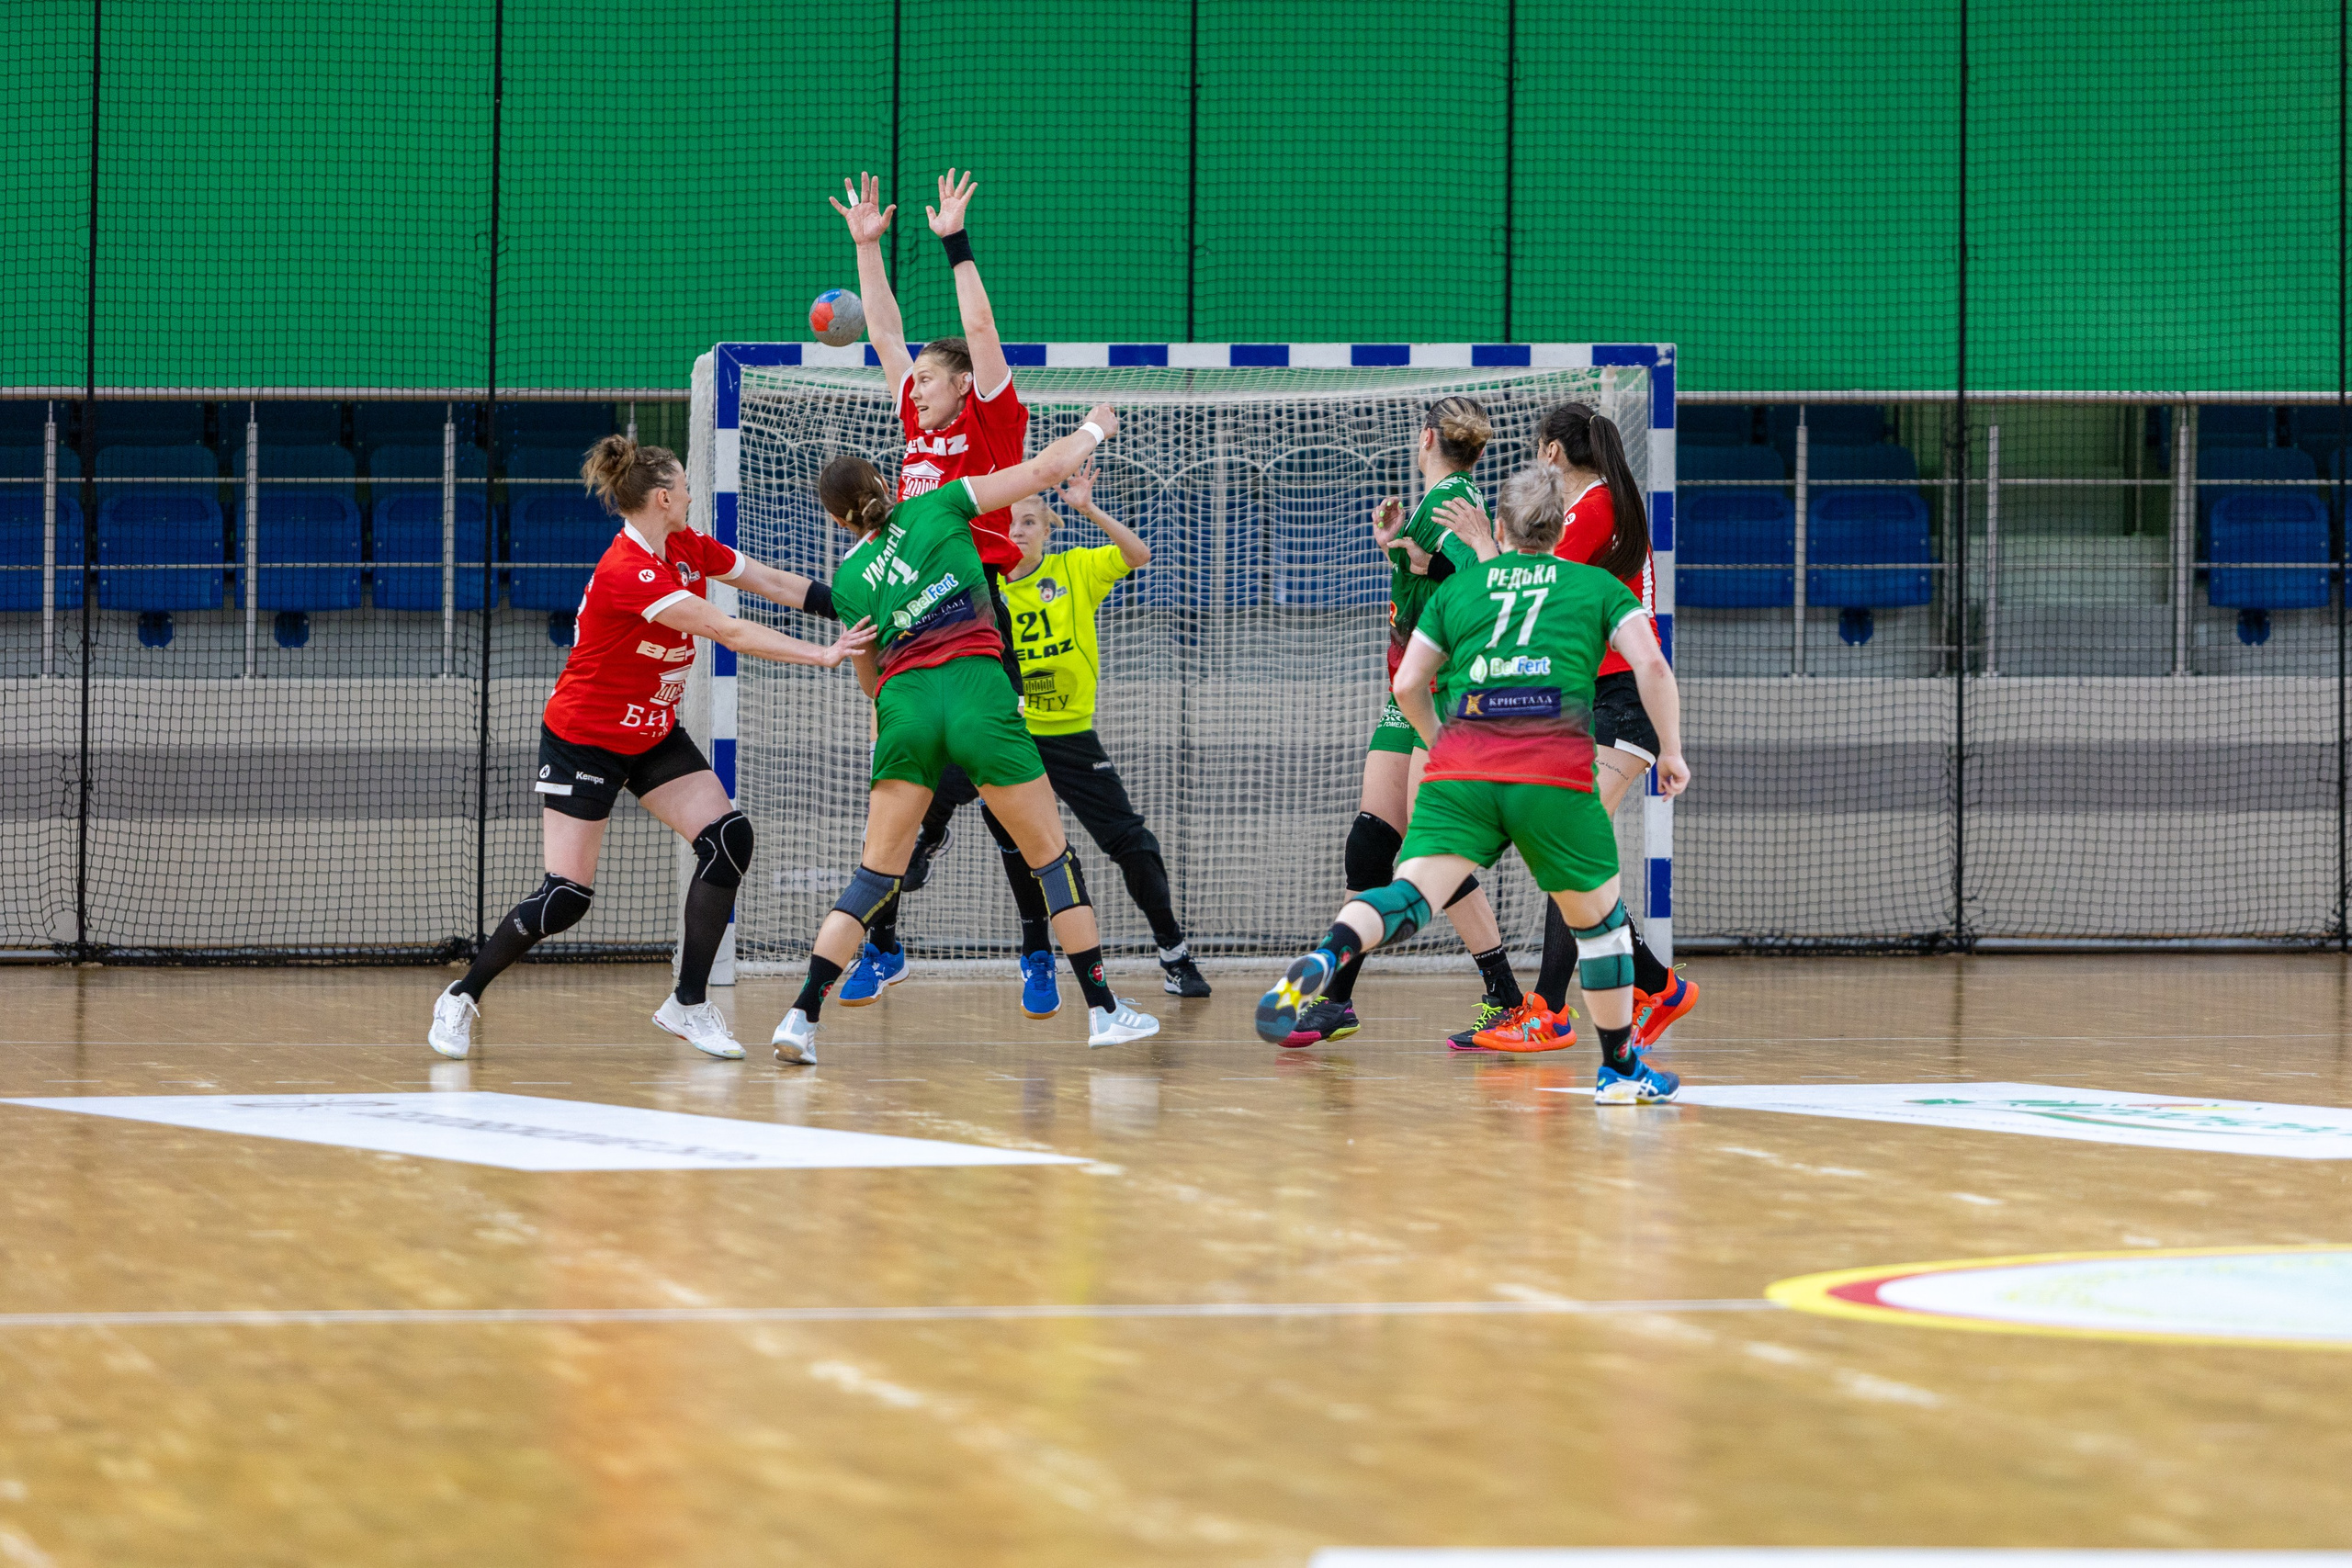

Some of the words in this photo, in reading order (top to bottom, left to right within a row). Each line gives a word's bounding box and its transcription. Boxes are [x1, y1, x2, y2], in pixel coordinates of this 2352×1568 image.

[1487, 564, 1556, 590] РЕДЬКА
[906, 572, 959, 617] BelFert
[1016, 608, 1054, 643] 21
[1485, 587, 1549, 649] 77
[1014, 638, 1074, 660] ELAZ
[1490, 656, 1551, 677] BelFert
[575, 771, 605, 784] Kempa
